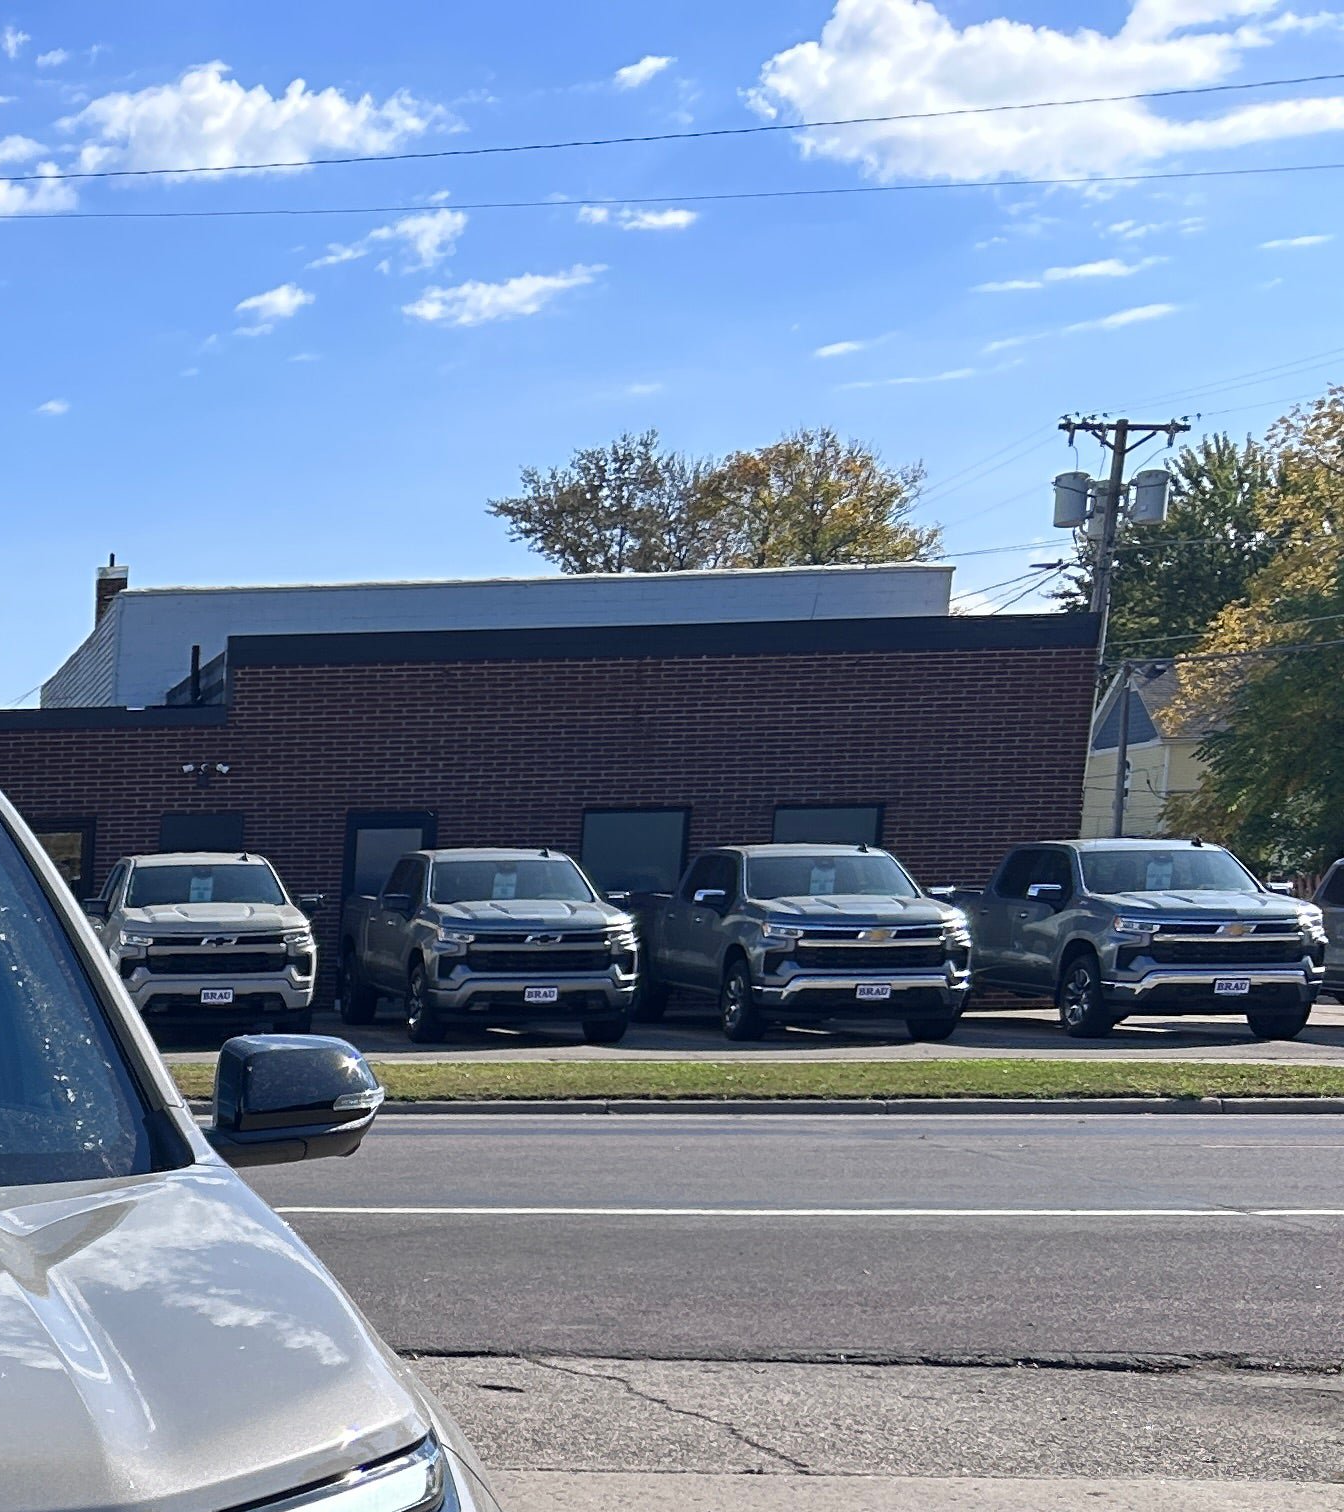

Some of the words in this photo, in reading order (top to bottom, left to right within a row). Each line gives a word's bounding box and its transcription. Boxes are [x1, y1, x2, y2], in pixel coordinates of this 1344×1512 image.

[1216, 982, 1247, 991] BRAU
[203, 991, 231, 1000] BRAU
[527, 990, 556, 999] BRAU
[858, 987, 889, 996] BRAU
